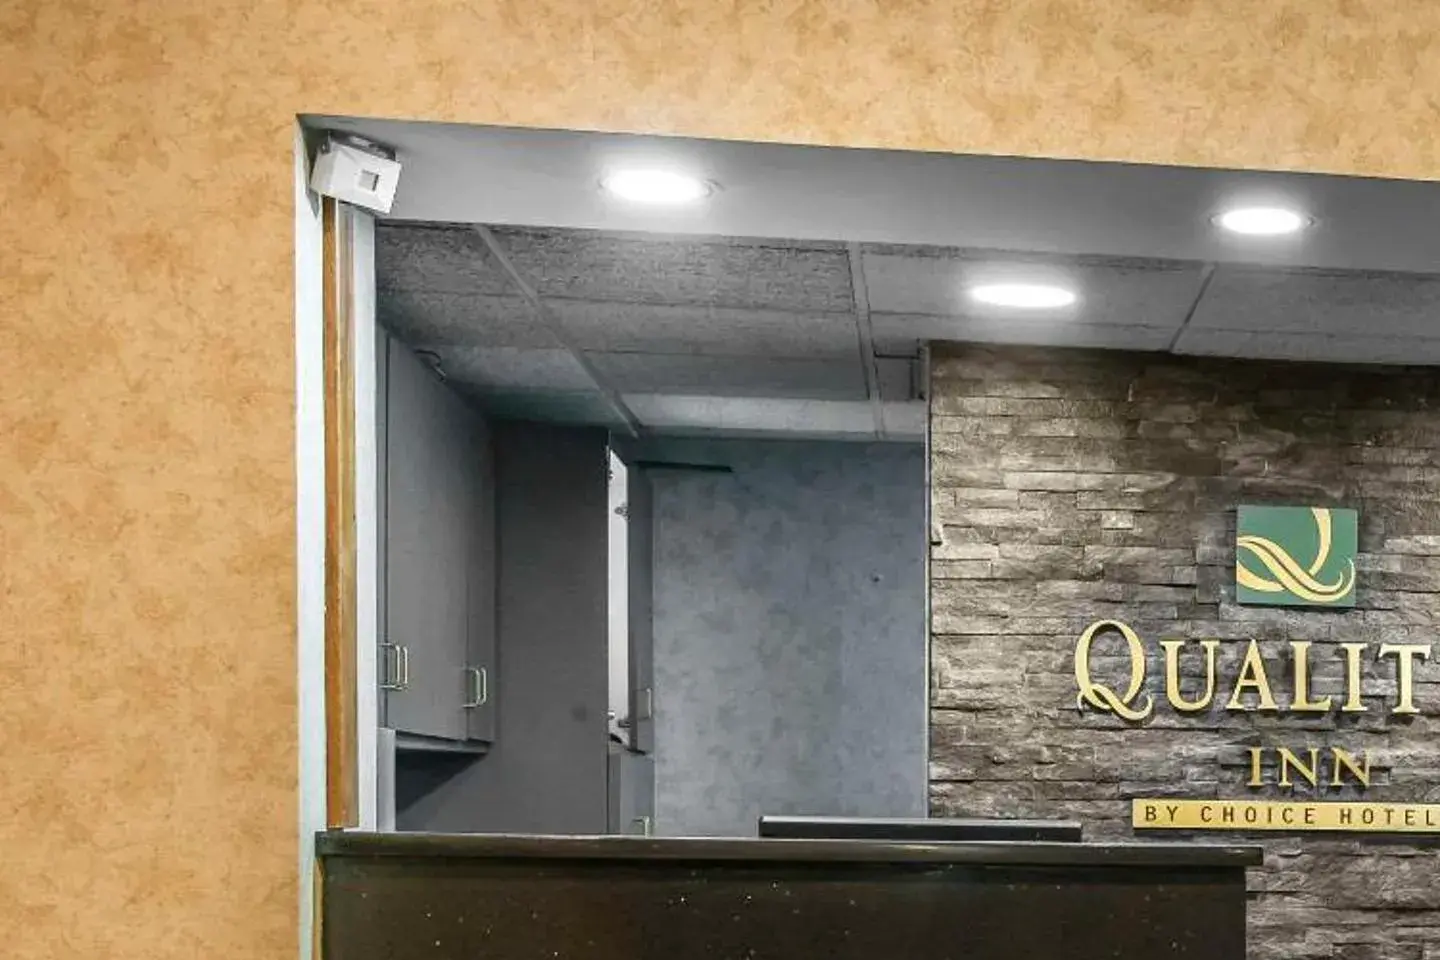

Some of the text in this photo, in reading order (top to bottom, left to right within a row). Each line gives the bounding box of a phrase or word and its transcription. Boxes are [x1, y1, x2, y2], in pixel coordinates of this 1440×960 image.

[1246, 745, 1374, 788] INN
[1145, 806, 1179, 822] BY
[1200, 806, 1316, 825] CHOICE
